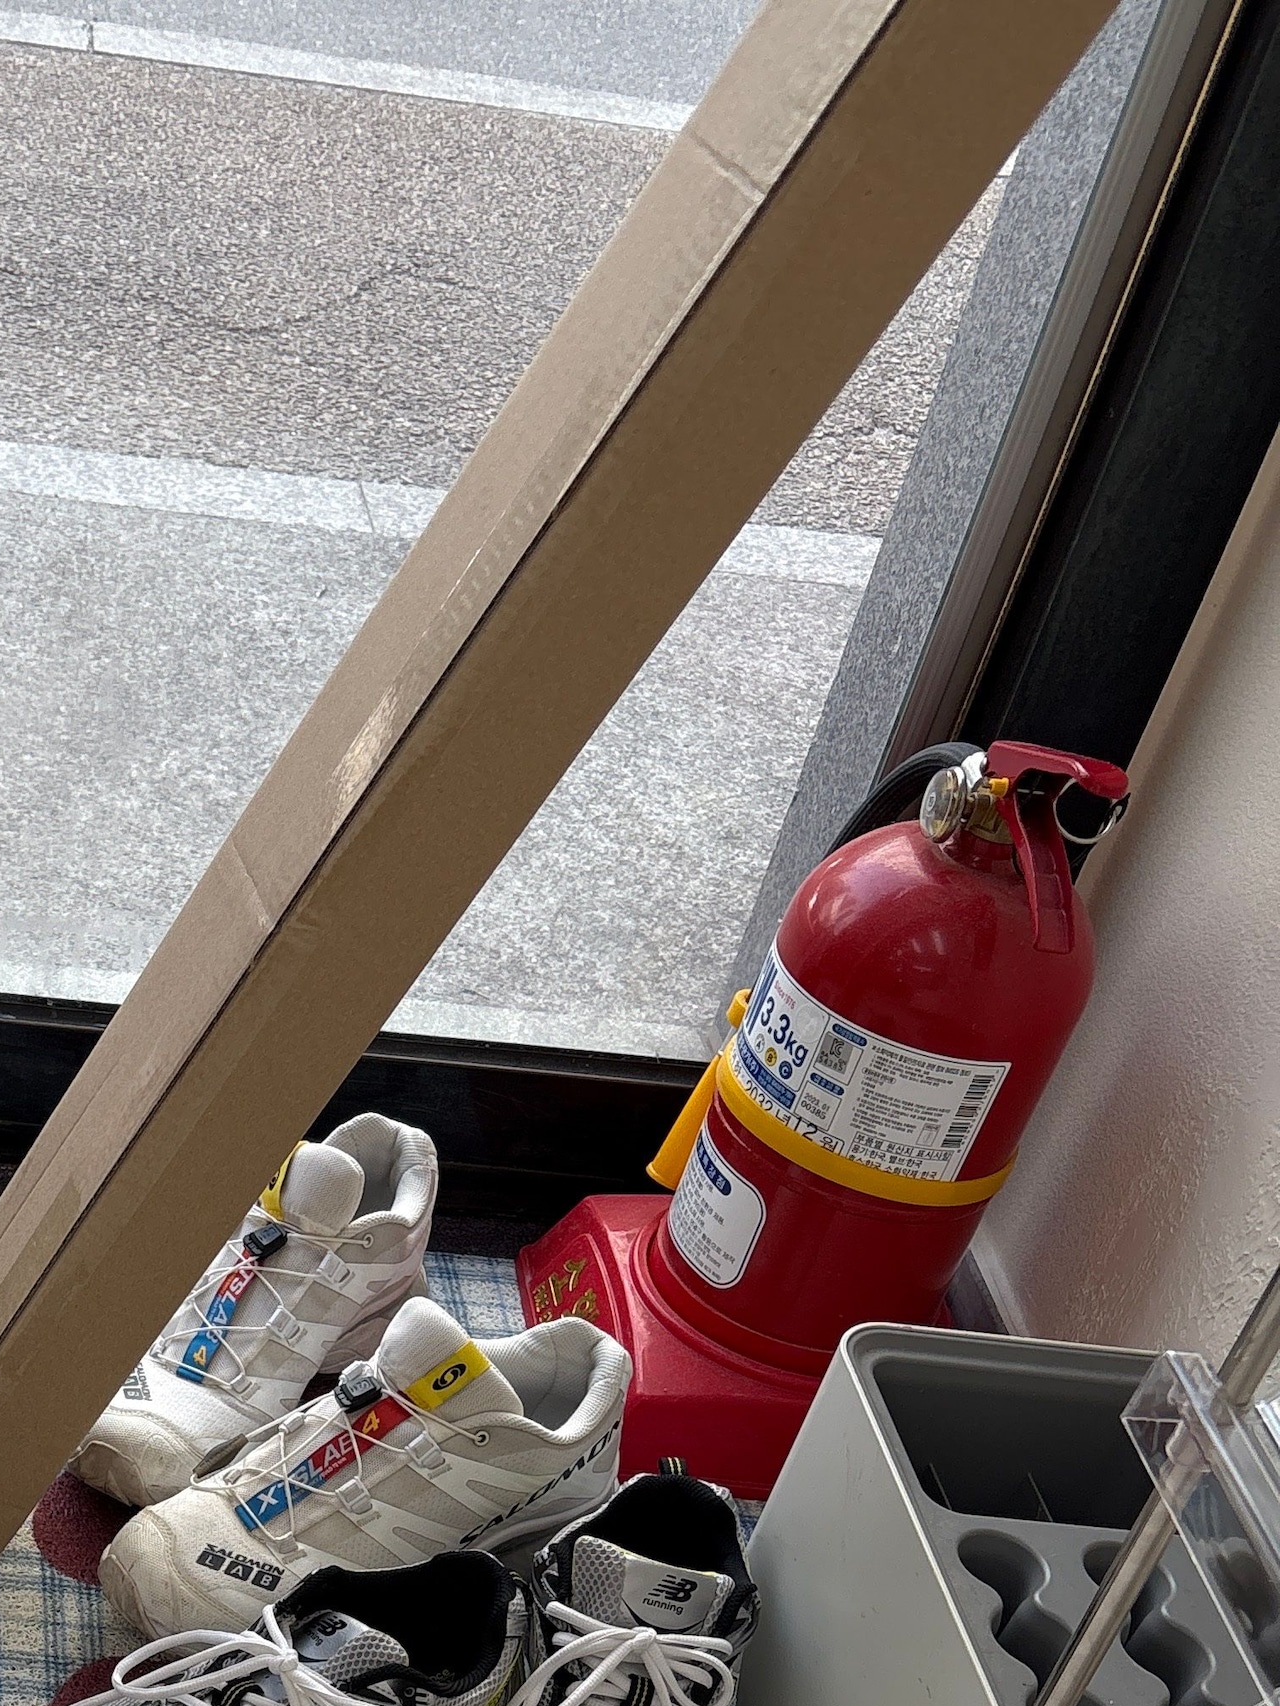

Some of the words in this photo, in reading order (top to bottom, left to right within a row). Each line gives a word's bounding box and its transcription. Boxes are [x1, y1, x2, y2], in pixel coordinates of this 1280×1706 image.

[761, 996, 809, 1068] 3.3kg
[800, 1100, 827, 1120] 00385
[793, 1116, 818, 1142] 12
[856, 1134, 884, 1150] 부품별
[886, 1142, 913, 1158] 원산지
[915, 1149, 952, 1162] 표시사항
[193, 1345, 206, 1366] 4
[363, 1411, 380, 1434] 4
[197, 1553, 282, 1591] LAB
[204, 1542, 286, 1577] SALOMON
[642, 1597, 685, 1616] running
